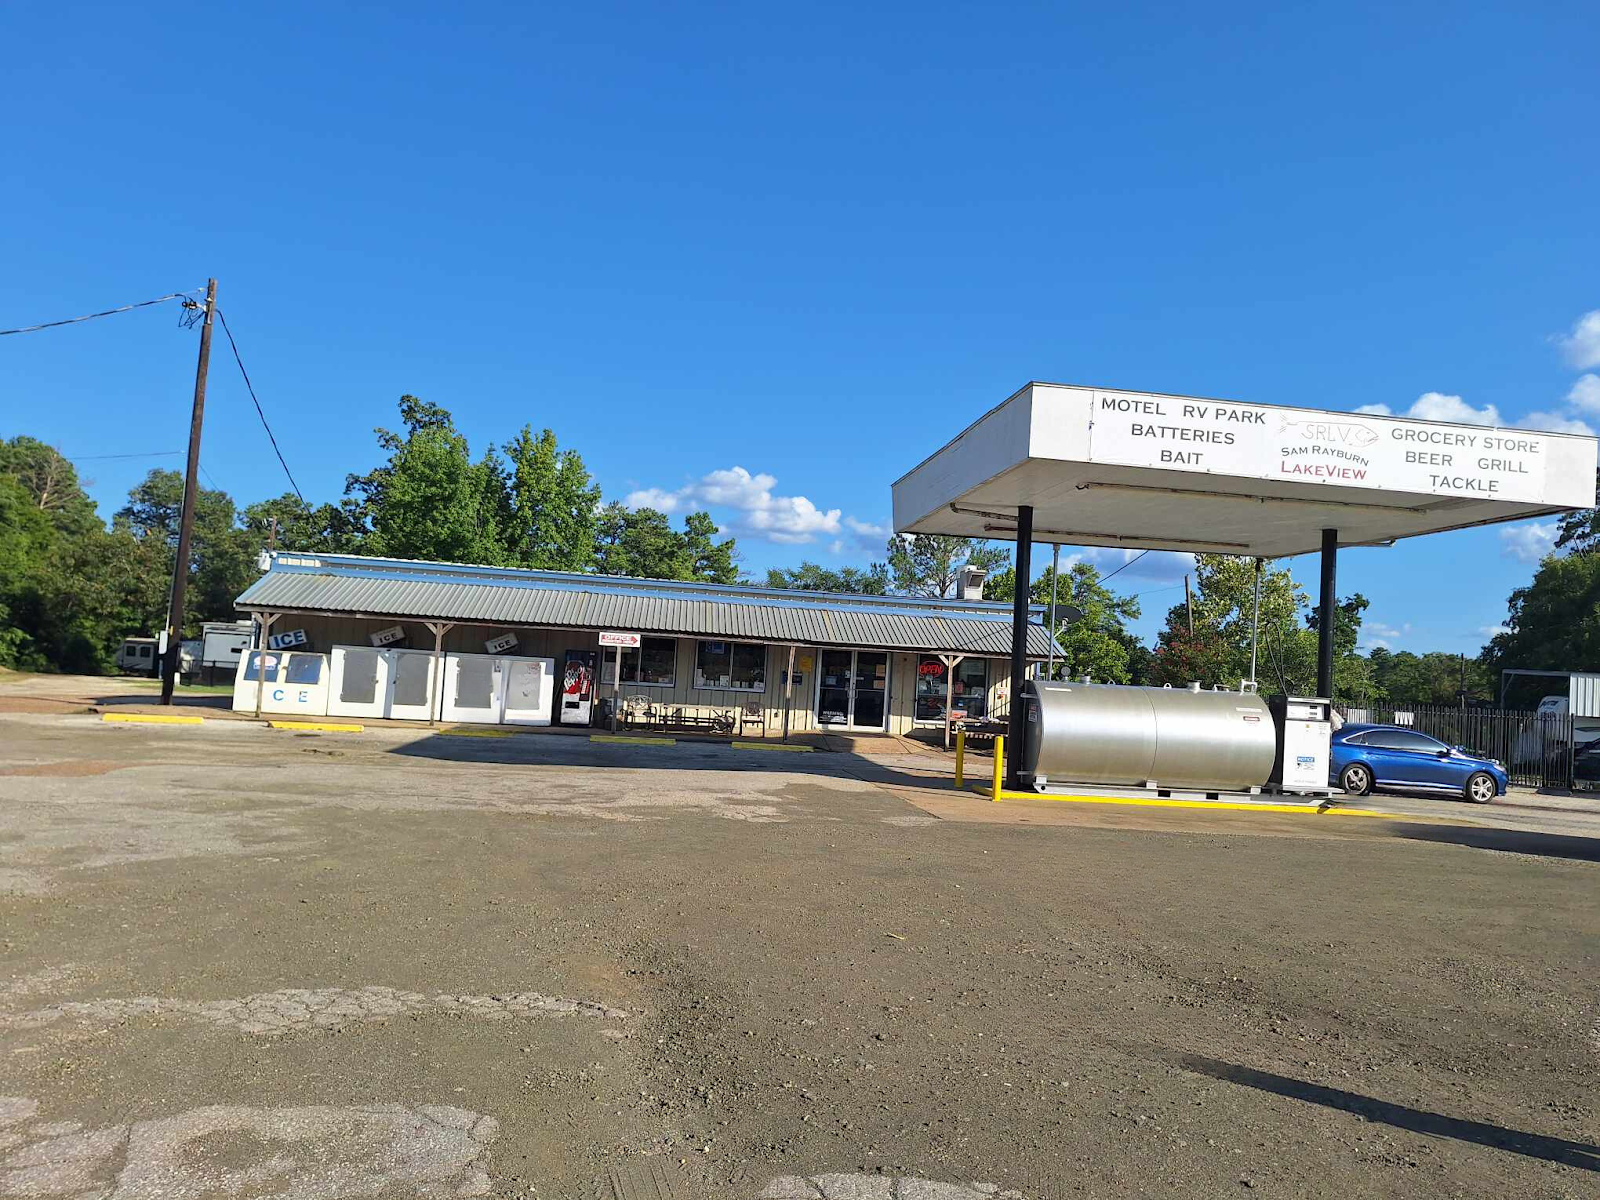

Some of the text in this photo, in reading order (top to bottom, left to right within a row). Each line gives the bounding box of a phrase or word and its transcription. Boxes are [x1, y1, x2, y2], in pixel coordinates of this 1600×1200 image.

[1101, 397, 1267, 425] MOTEL RV PARK
[1131, 423, 1235, 445] BATTERIES
[1301, 424, 1351, 442] SRLV
[1391, 428, 1540, 454] GROCERY STORE
[1160, 450, 1204, 465] BAIT
[1405, 451, 1529, 474] BEER GRILL
[1430, 474, 1500, 492] TACKLE
[273, 630, 304, 648] ICE
[379, 632, 398, 643] ICE
[494, 639, 512, 651] ICE
[919, 664, 943, 675] OPEN
